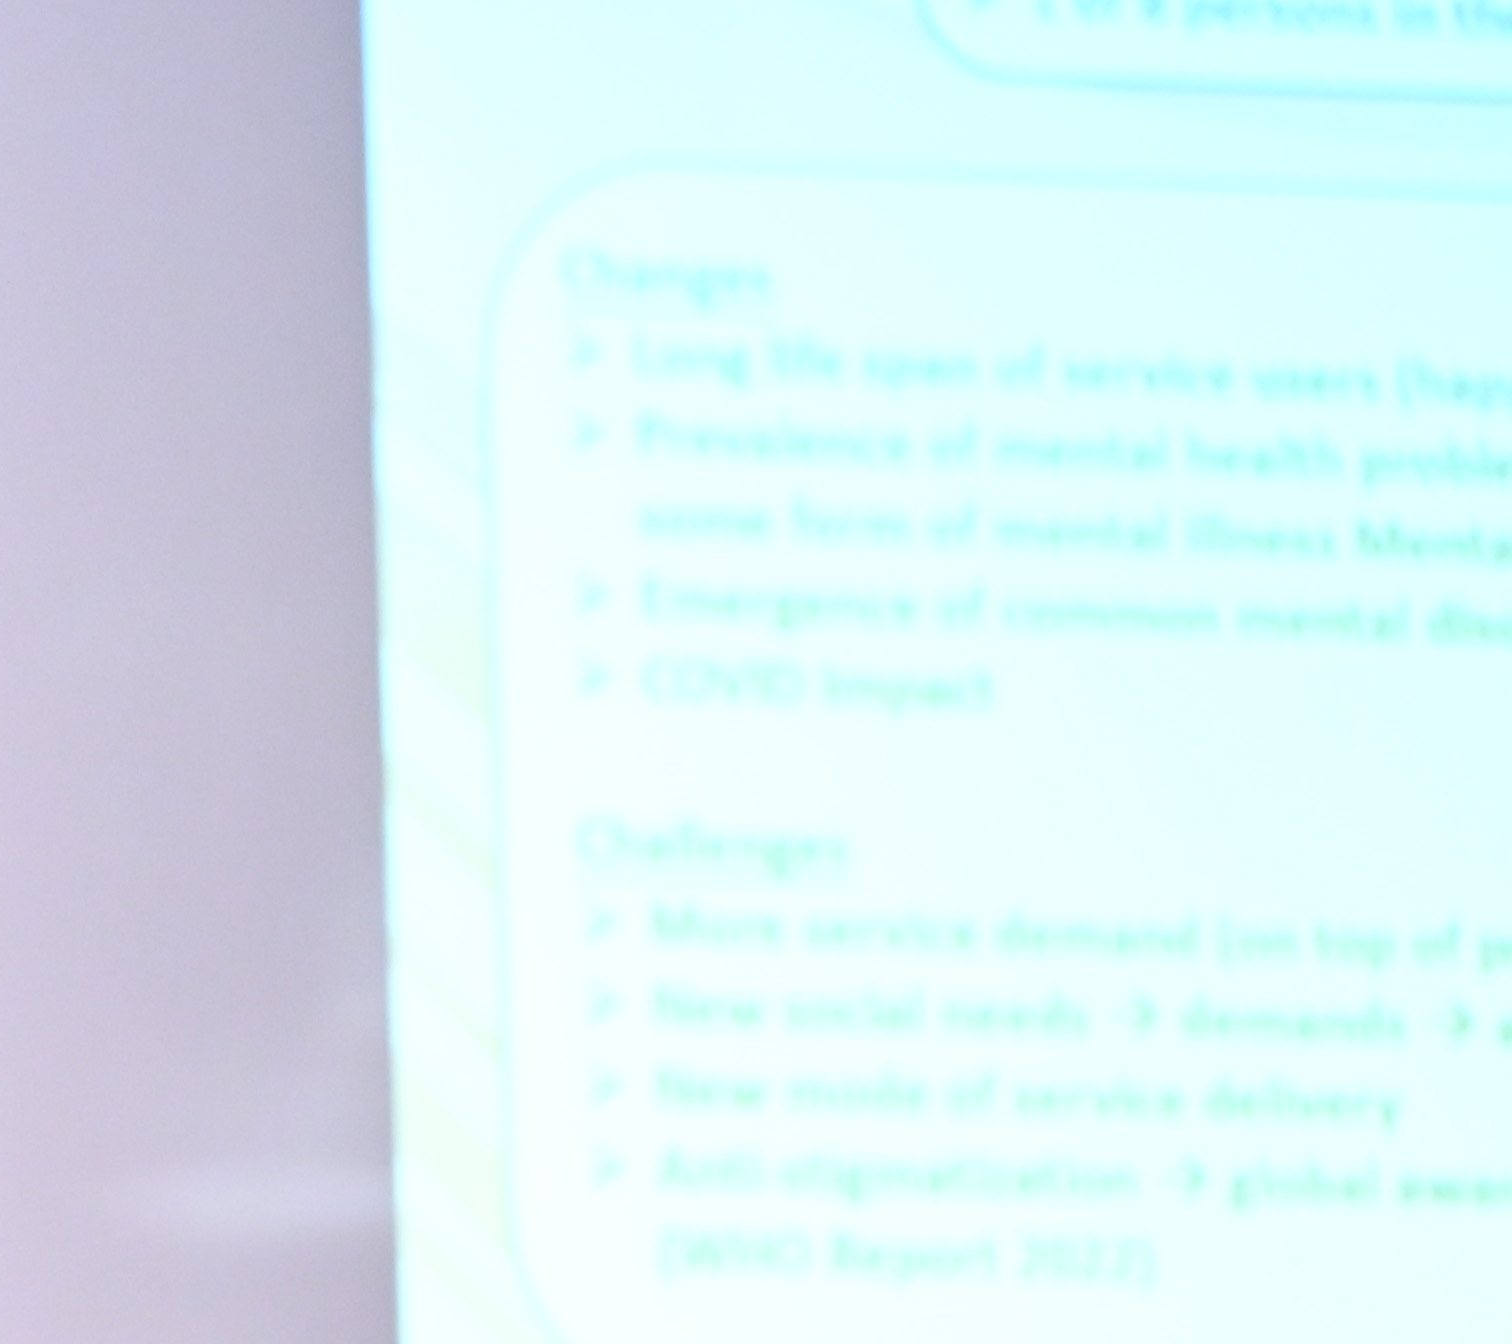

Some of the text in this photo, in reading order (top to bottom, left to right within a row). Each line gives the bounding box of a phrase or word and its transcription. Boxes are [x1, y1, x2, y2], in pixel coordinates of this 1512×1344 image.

[559, 243, 772, 310] Changes
[631, 328, 752, 392] Long
[862, 345, 976, 400] span
[992, 338, 1048, 388] of
[1062, 345, 1232, 394] service
[632, 408, 911, 470] Prevalence
[927, 408, 981, 472] of
[994, 420, 1170, 475] mental
[1184, 423, 1344, 480] health
[636, 498, 771, 542] some
[927, 490, 981, 552] of
[994, 503, 1170, 557] mental
[637, 570, 921, 635] Emergence
[936, 575, 988, 634] of
[998, 588, 1219, 638] common
[1234, 590, 1411, 645] mental
[639, 652, 809, 710] COVID
[574, 812, 852, 880] Challenges
[649, 895, 782, 950] More
[804, 905, 976, 955] service
[996, 903, 1201, 960] demand
[1314, 913, 1399, 975] top
[1411, 915, 1464, 970] of
[649, 982, 766, 1037] New
[941, 990, 1092, 1042] needs
[1181, 993, 1408, 1048] demands
[651, 1065, 1406, 1145] New mode of service delivery
[1229, 1150, 1384, 1215] global
[659, 1225, 814, 1290] (WHO
[830, 1228, 997, 1292] Report
